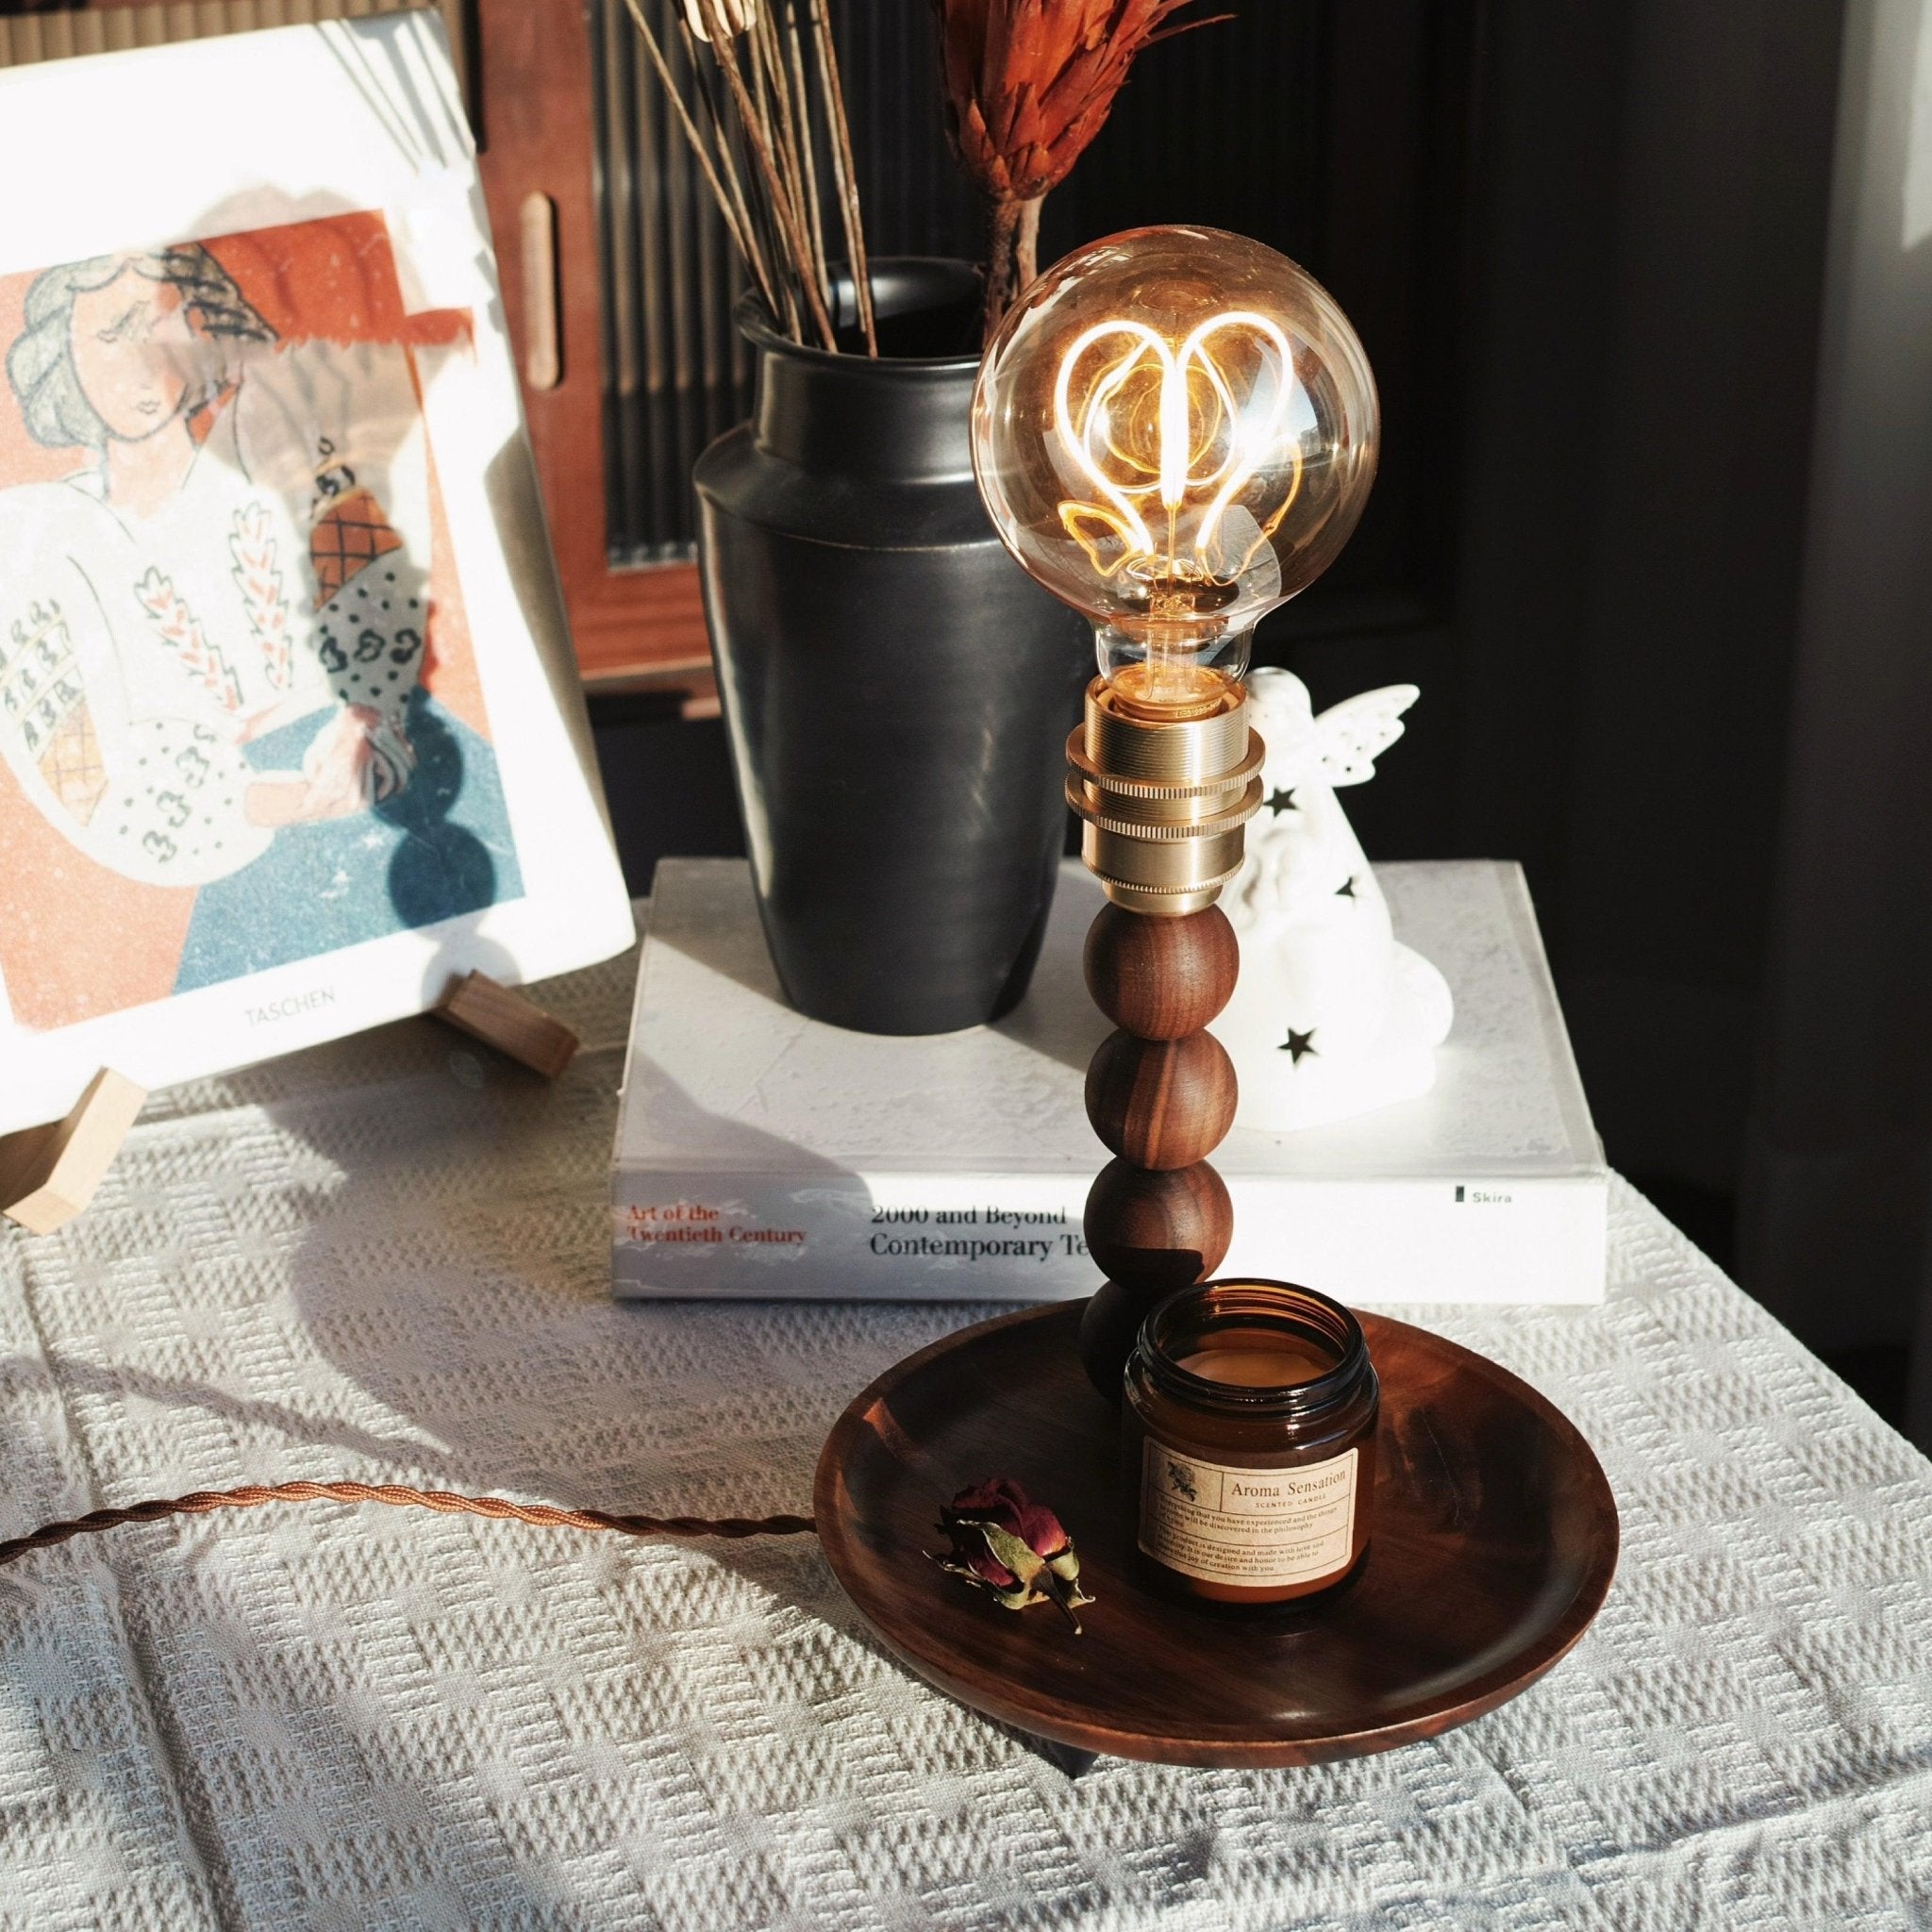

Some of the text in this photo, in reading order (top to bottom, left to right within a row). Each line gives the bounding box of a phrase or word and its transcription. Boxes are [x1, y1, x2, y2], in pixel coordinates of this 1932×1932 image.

[244, 986, 335, 1026] TASCHEN
[1473, 1191, 1512, 1203] Skira
[627, 1204, 720, 1221] Art of the
[871, 1206, 1067, 1229] 2000 and Beyond
[627, 1226, 807, 1245] Twentieth Century
[870, 1233, 1053, 1261] Contemporary
[1231, 1470, 1346, 1497] Aroma Sensation
[1298, 1494, 1326, 1506] CANDLE
[1185, 1515, 1198, 1524] will
[1199, 1518, 1208, 1526] be
[1209, 1522, 1251, 1533] discovered
[1274, 1523, 1313, 1535] philosophy
[1196, 1508, 1210, 1520] that
[1211, 1515, 1225, 1524] you
[1226, 1517, 1245, 1525] have
[1246, 1518, 1291, 1527] experienced
[1292, 1515, 1306, 1524] and
[1307, 1512, 1317, 1521] the
[1207, 1543, 1241, 1556] designed
[1279, 1546, 1295, 1555] with
[1296, 1543, 1310, 1553] love
[1209, 1561, 1241, 1571] creation
